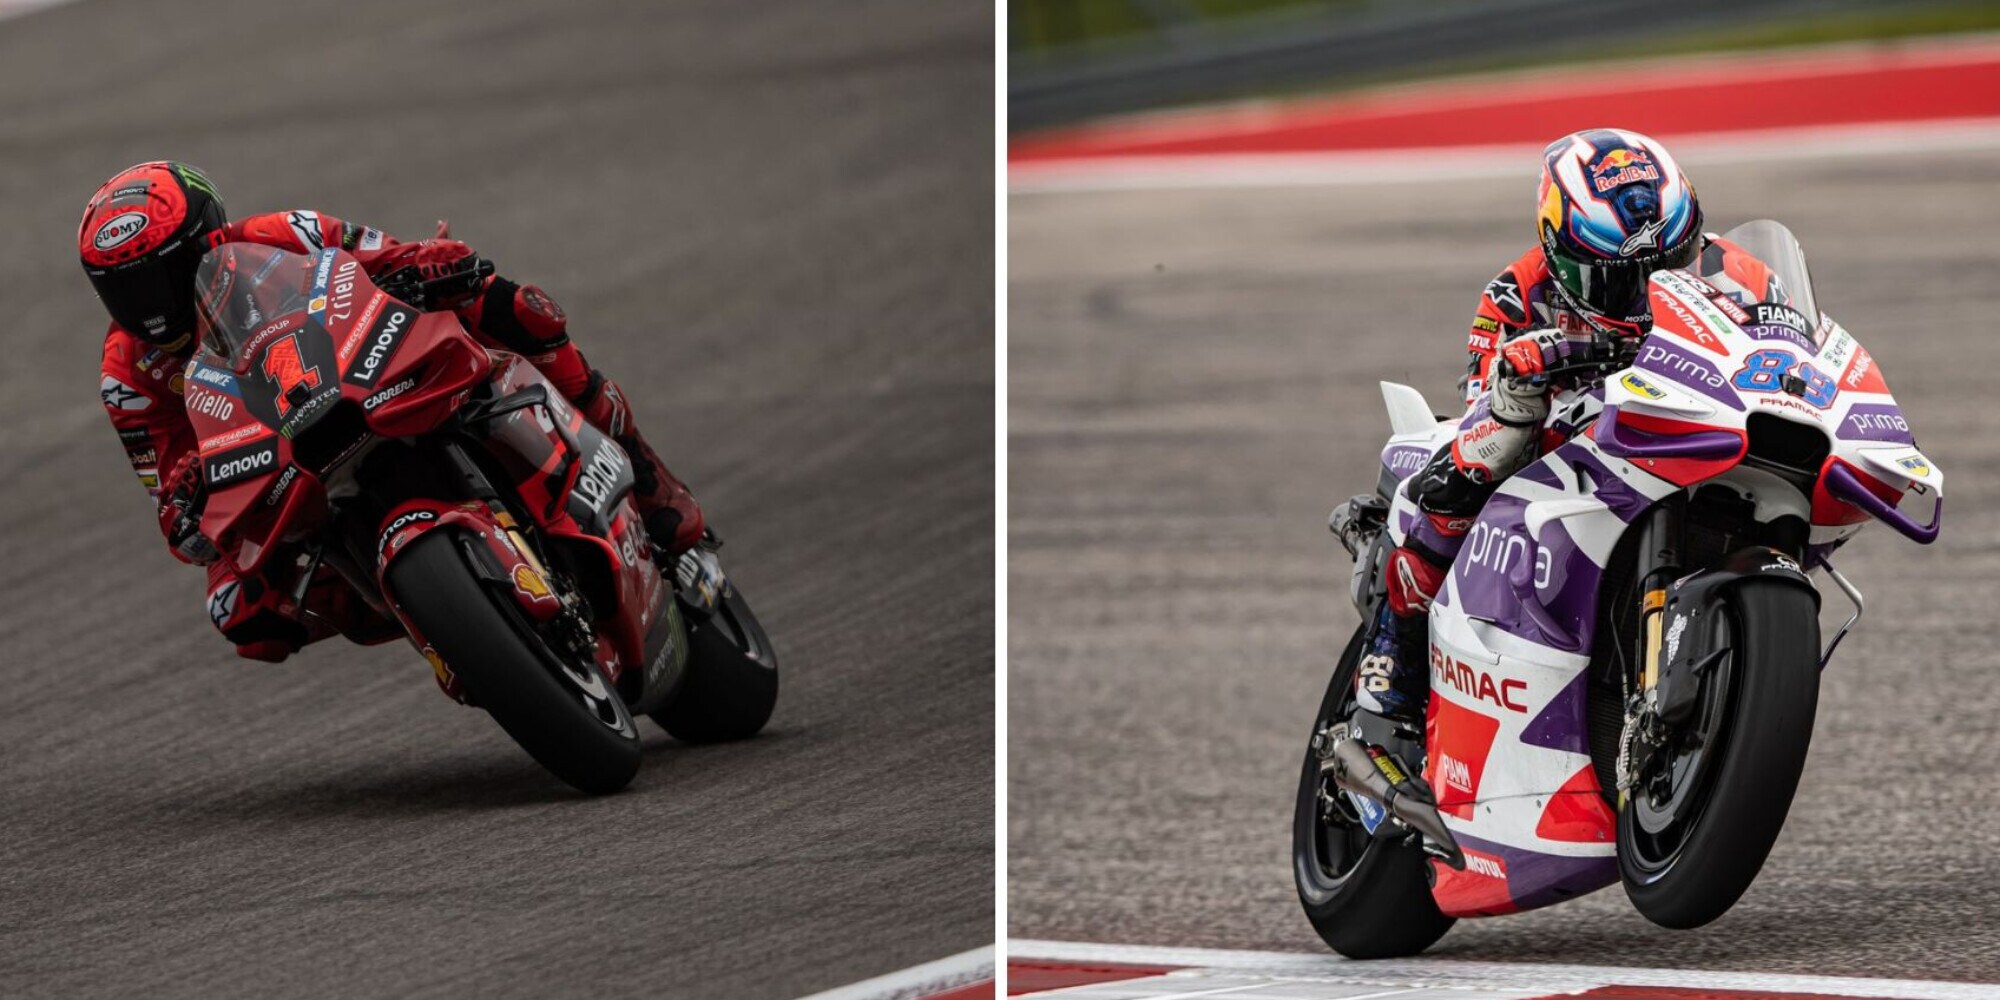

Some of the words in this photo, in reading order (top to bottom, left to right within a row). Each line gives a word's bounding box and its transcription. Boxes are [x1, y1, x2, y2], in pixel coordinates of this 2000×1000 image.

[1593, 168, 1629, 193] Red
[1628, 164, 1659, 182] Bull
[98, 219, 142, 243] SUOMY
[1653, 290, 1714, 344] PRAMAC
[1714, 297, 1748, 322] MOTUL
[1757, 305, 1806, 333] FIAMM
[353, 311, 407, 381] Lenovo
[1753, 325, 1809, 347] prima
[262, 333, 322, 419] 1
[1642, 345, 1725, 388] prima
[1730, 348, 1840, 411] 89
[363, 378, 415, 410] CARRERA
[1759, 397, 1823, 422] PRAMAC
[1849, 411, 1909, 434] prima
[210, 450, 273, 482] Lenovo
[571, 438, 625, 514] Lenovo
[1391, 449, 1430, 471] prima
[266, 466, 298, 506] CARRERA
[1464, 521, 1552, 590] prima
